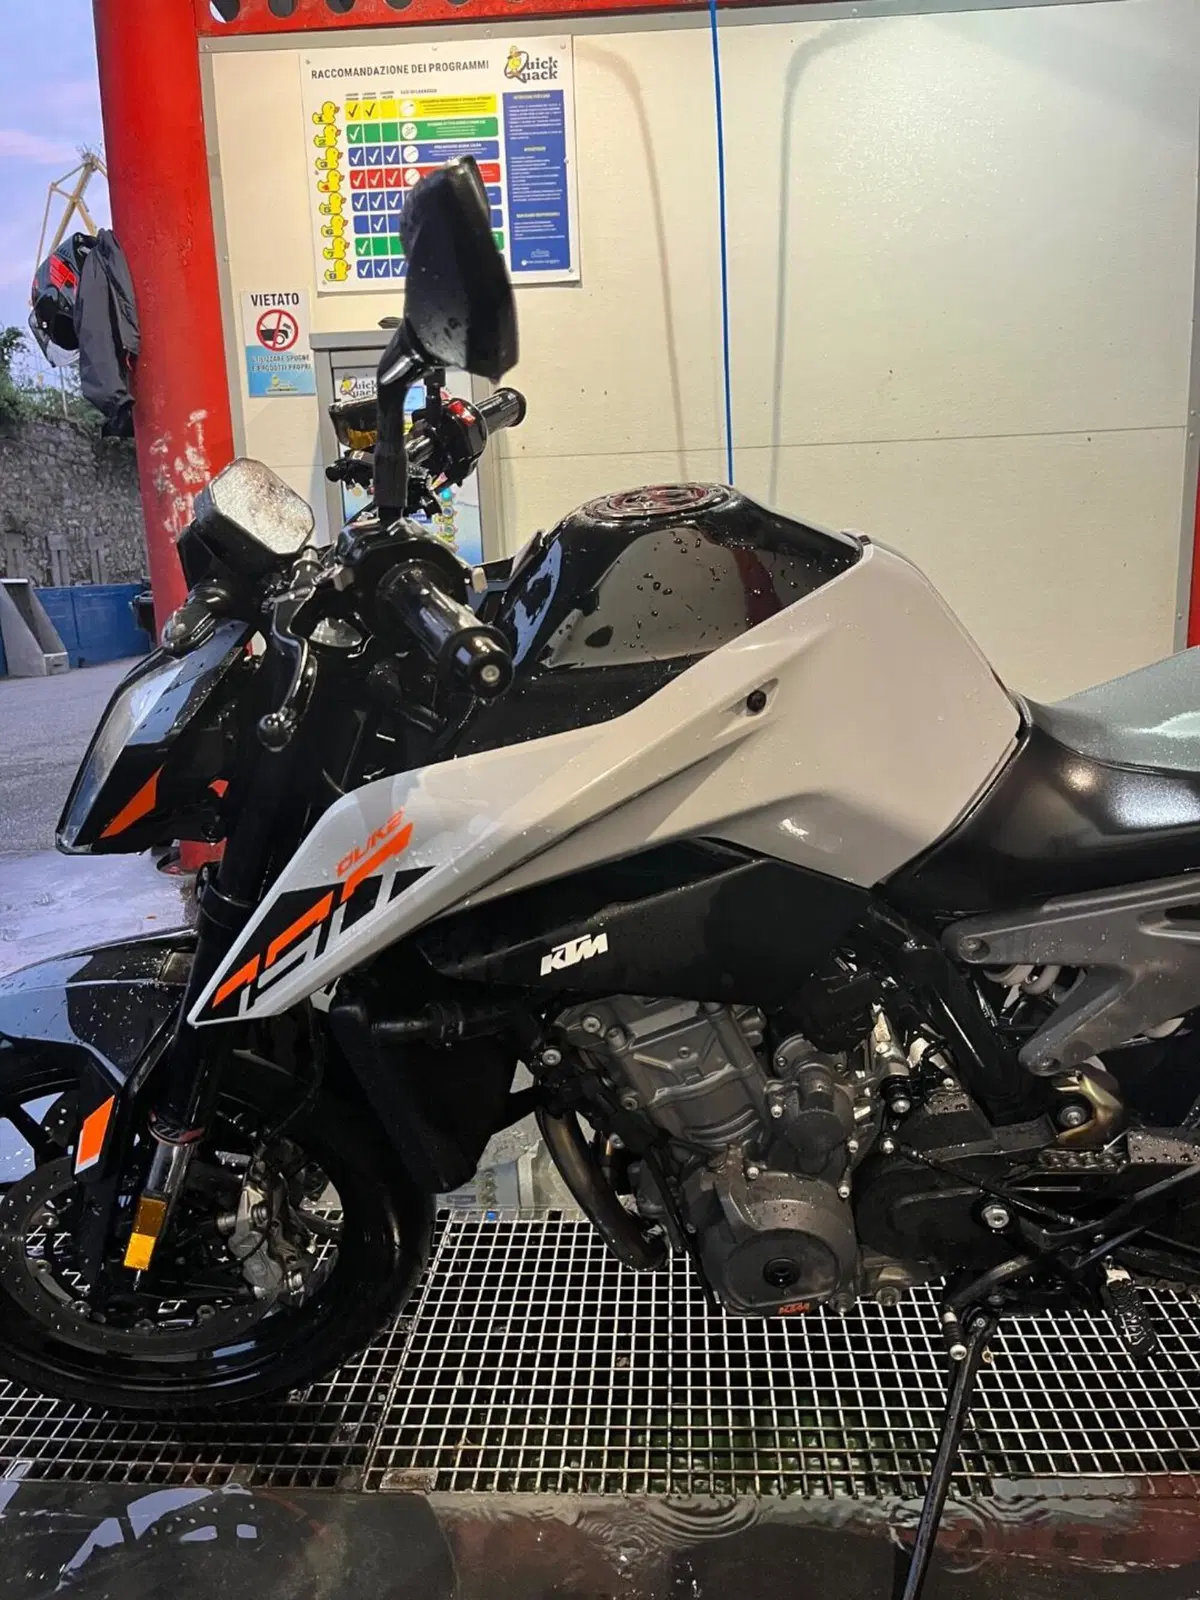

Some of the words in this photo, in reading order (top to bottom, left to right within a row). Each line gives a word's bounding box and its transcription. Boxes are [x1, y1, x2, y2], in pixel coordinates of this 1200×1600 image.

[311, 64, 409, 80] RACCOMANDAZIONE
[411, 63, 427, 74] DEI
[428, 60, 490, 73] PROGRAMMI
[250, 292, 300, 307] VIETATO
[540, 932, 609, 976] KTM
